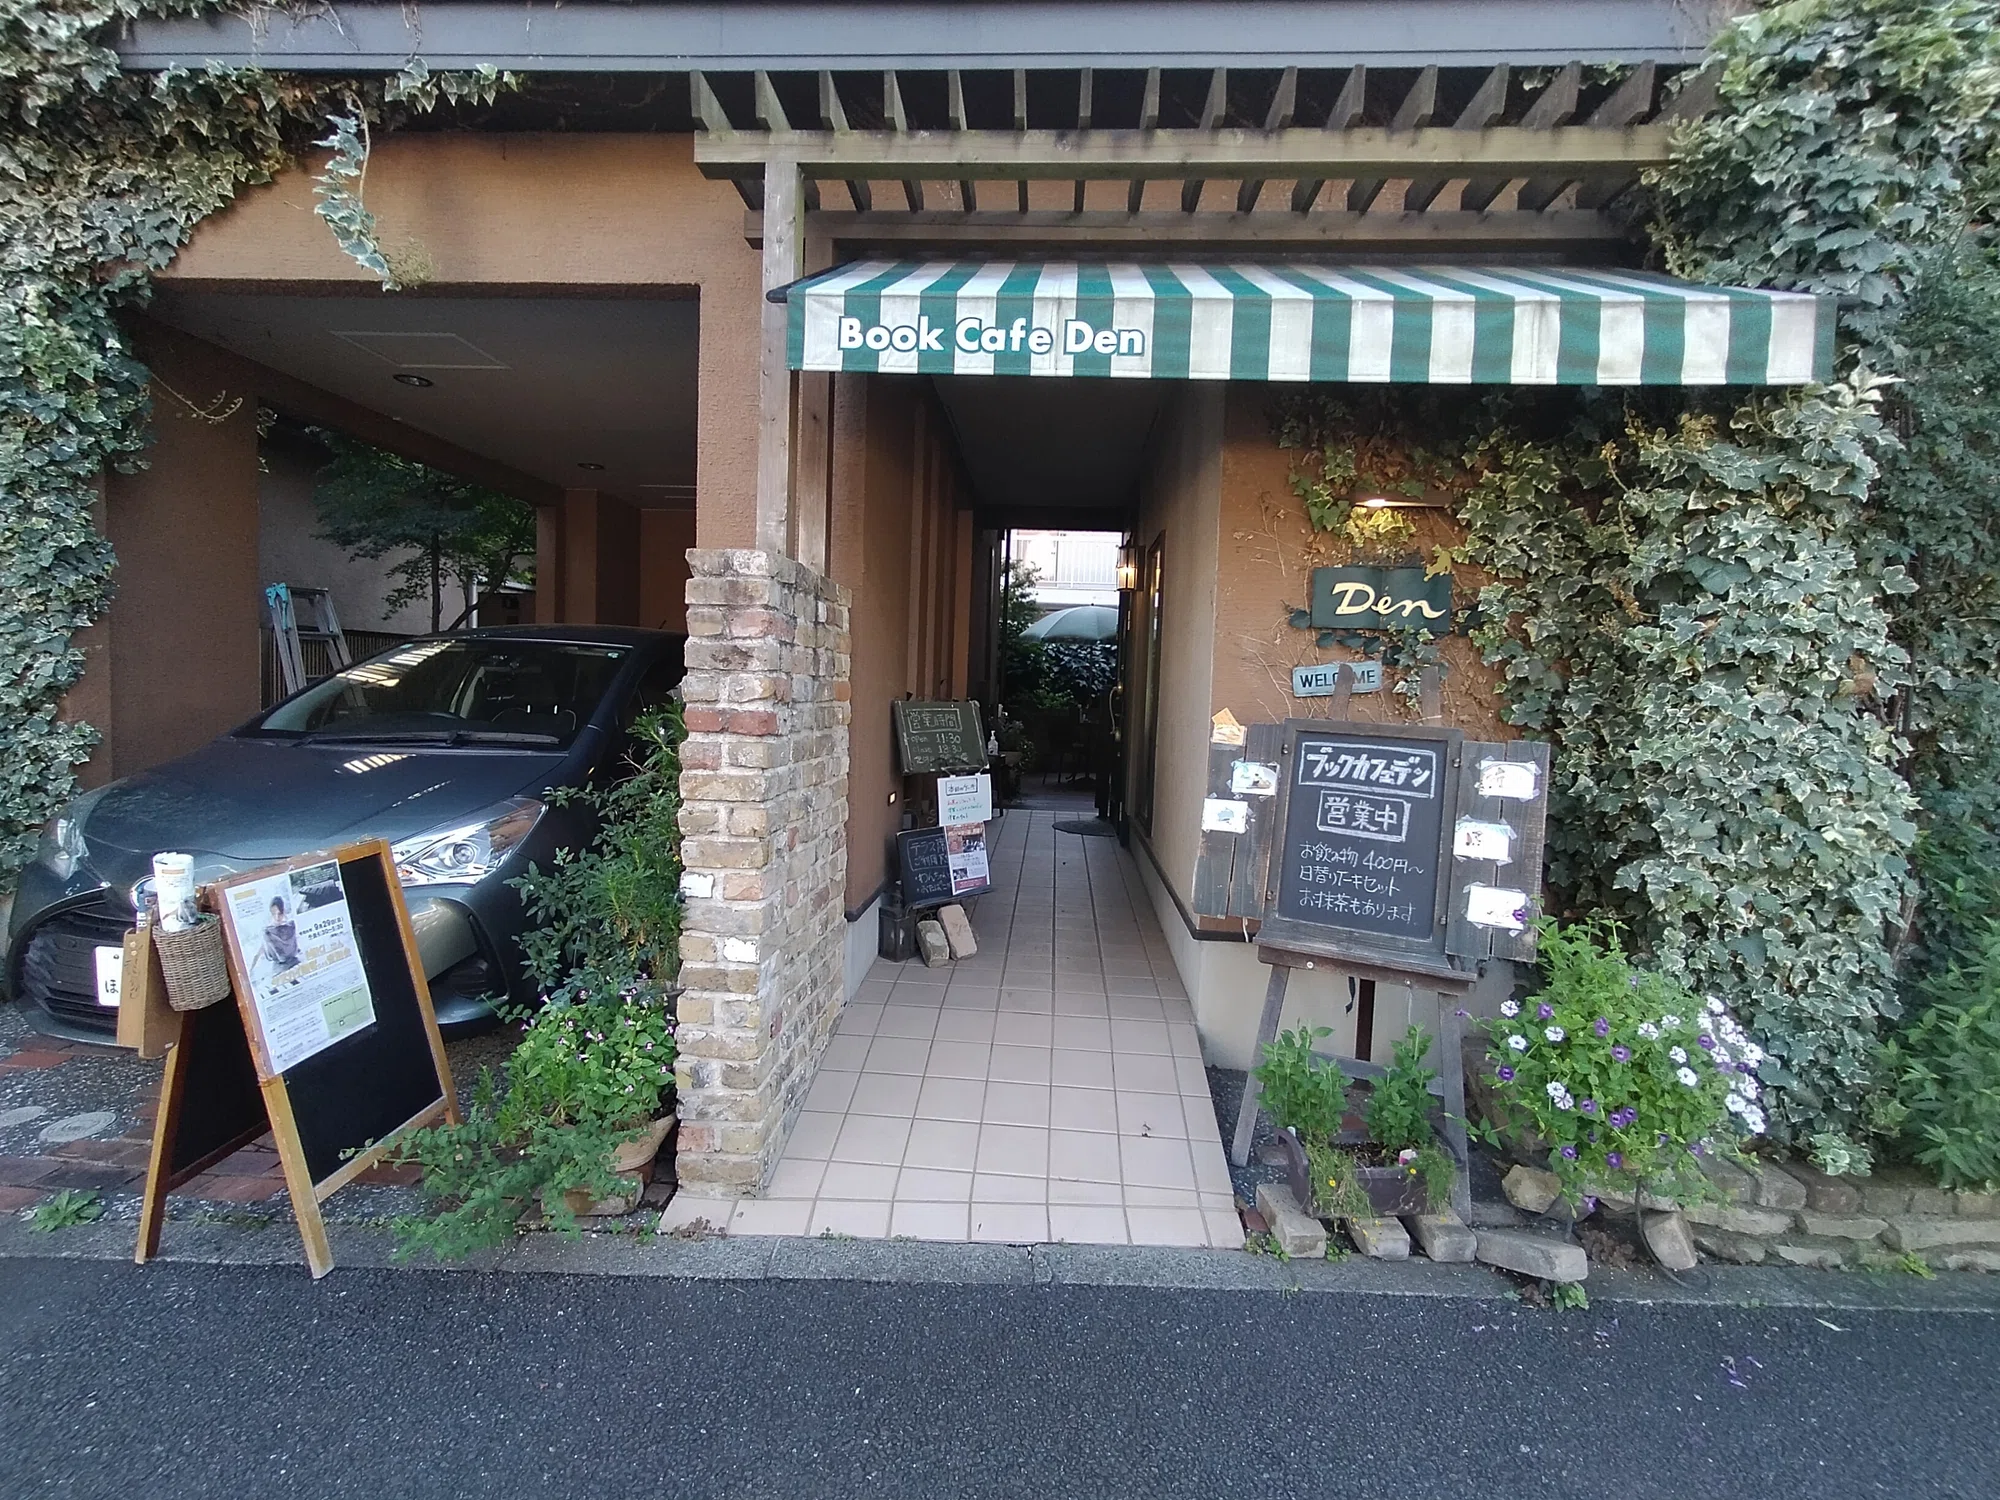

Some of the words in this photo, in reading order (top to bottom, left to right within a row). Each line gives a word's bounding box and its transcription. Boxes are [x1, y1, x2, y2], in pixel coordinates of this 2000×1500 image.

[839, 316, 944, 351] Book
[955, 317, 1053, 354] Cafe
[1064, 319, 1145, 356] Den
[1332, 582, 1447, 619] Den
[936, 733, 961, 744] 11:30
[1307, 747, 1431, 787] ブックカフェデン
[1324, 797, 1398, 831] 営業中
[1299, 841, 1358, 867] お飲み物
[1299, 865, 1400, 897] 日替りケーキセット
[104, 979, 119, 994] ほ
